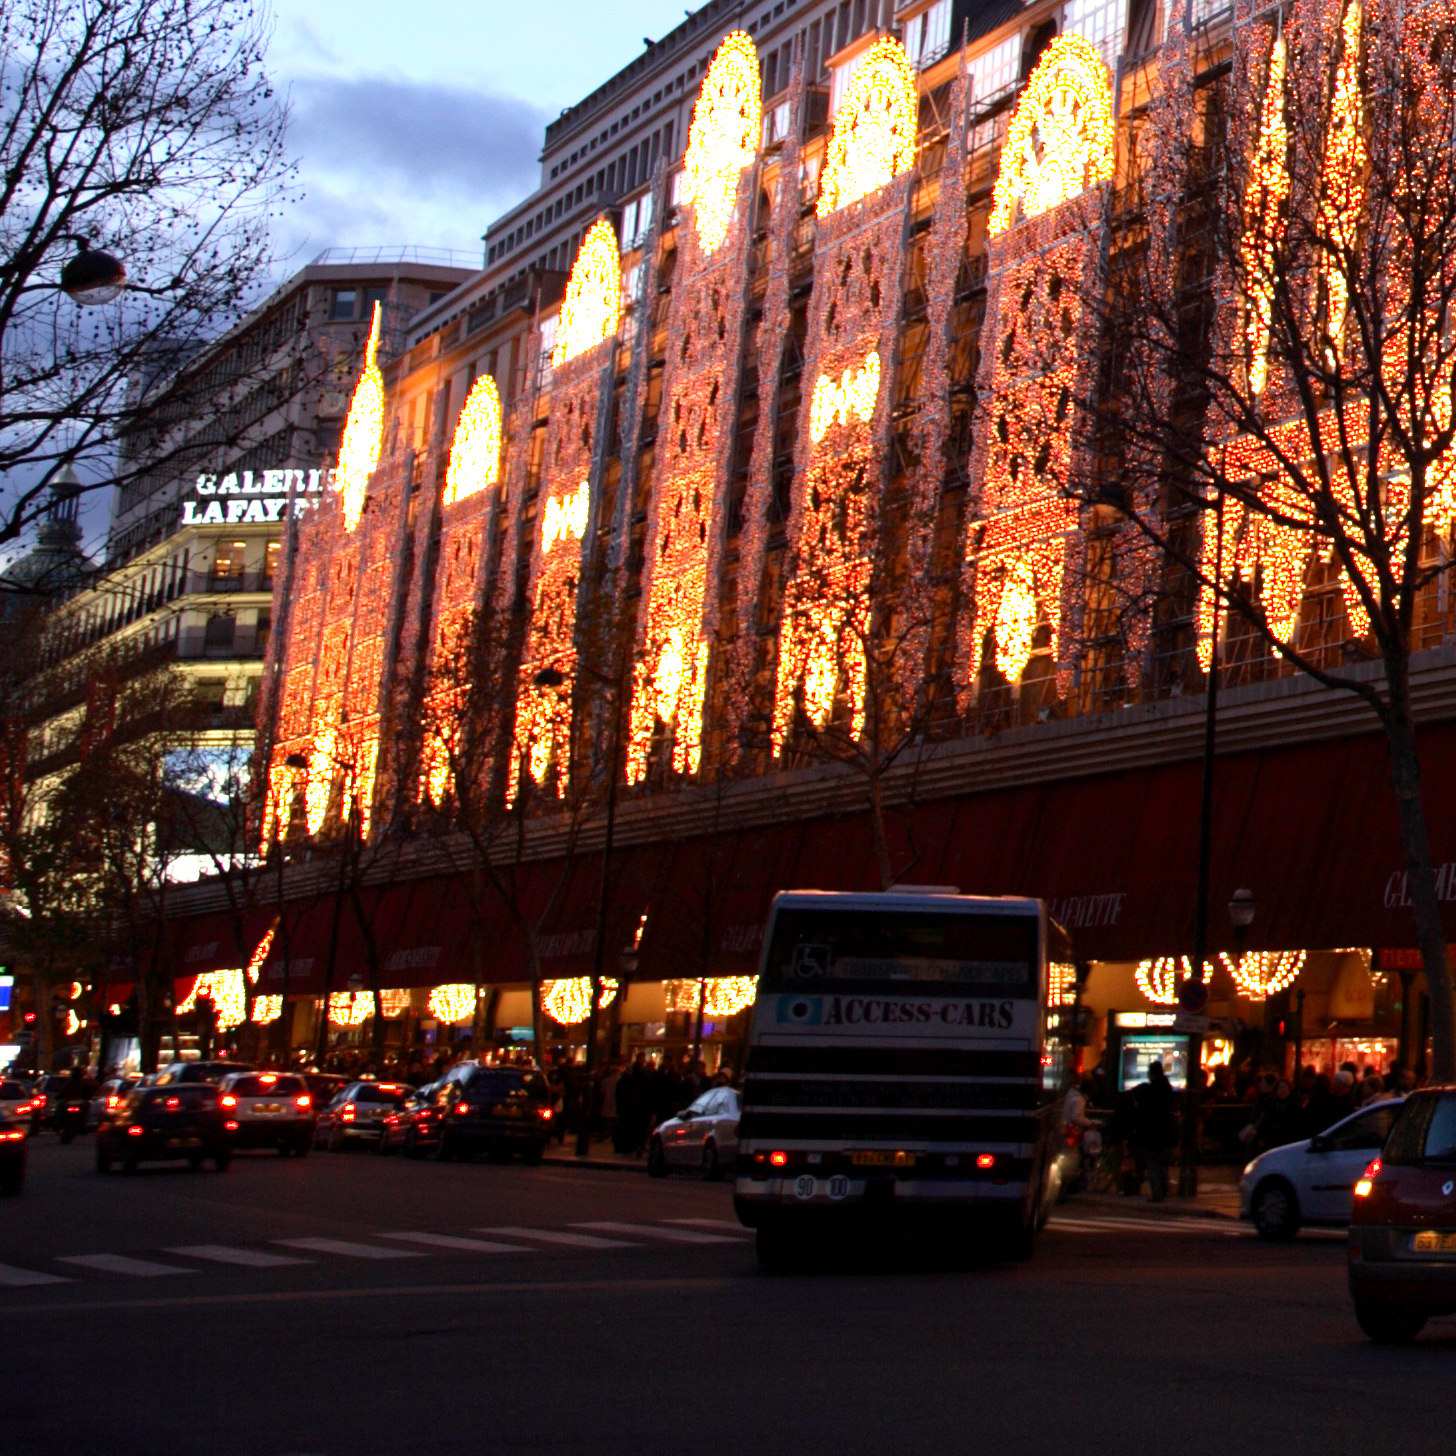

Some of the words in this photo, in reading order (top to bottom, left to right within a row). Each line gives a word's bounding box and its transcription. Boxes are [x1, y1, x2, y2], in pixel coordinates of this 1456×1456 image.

[825, 997, 1015, 1029] ACCESS-CARS
[798, 1177, 814, 1196] 90
[830, 1177, 847, 1197] 100
